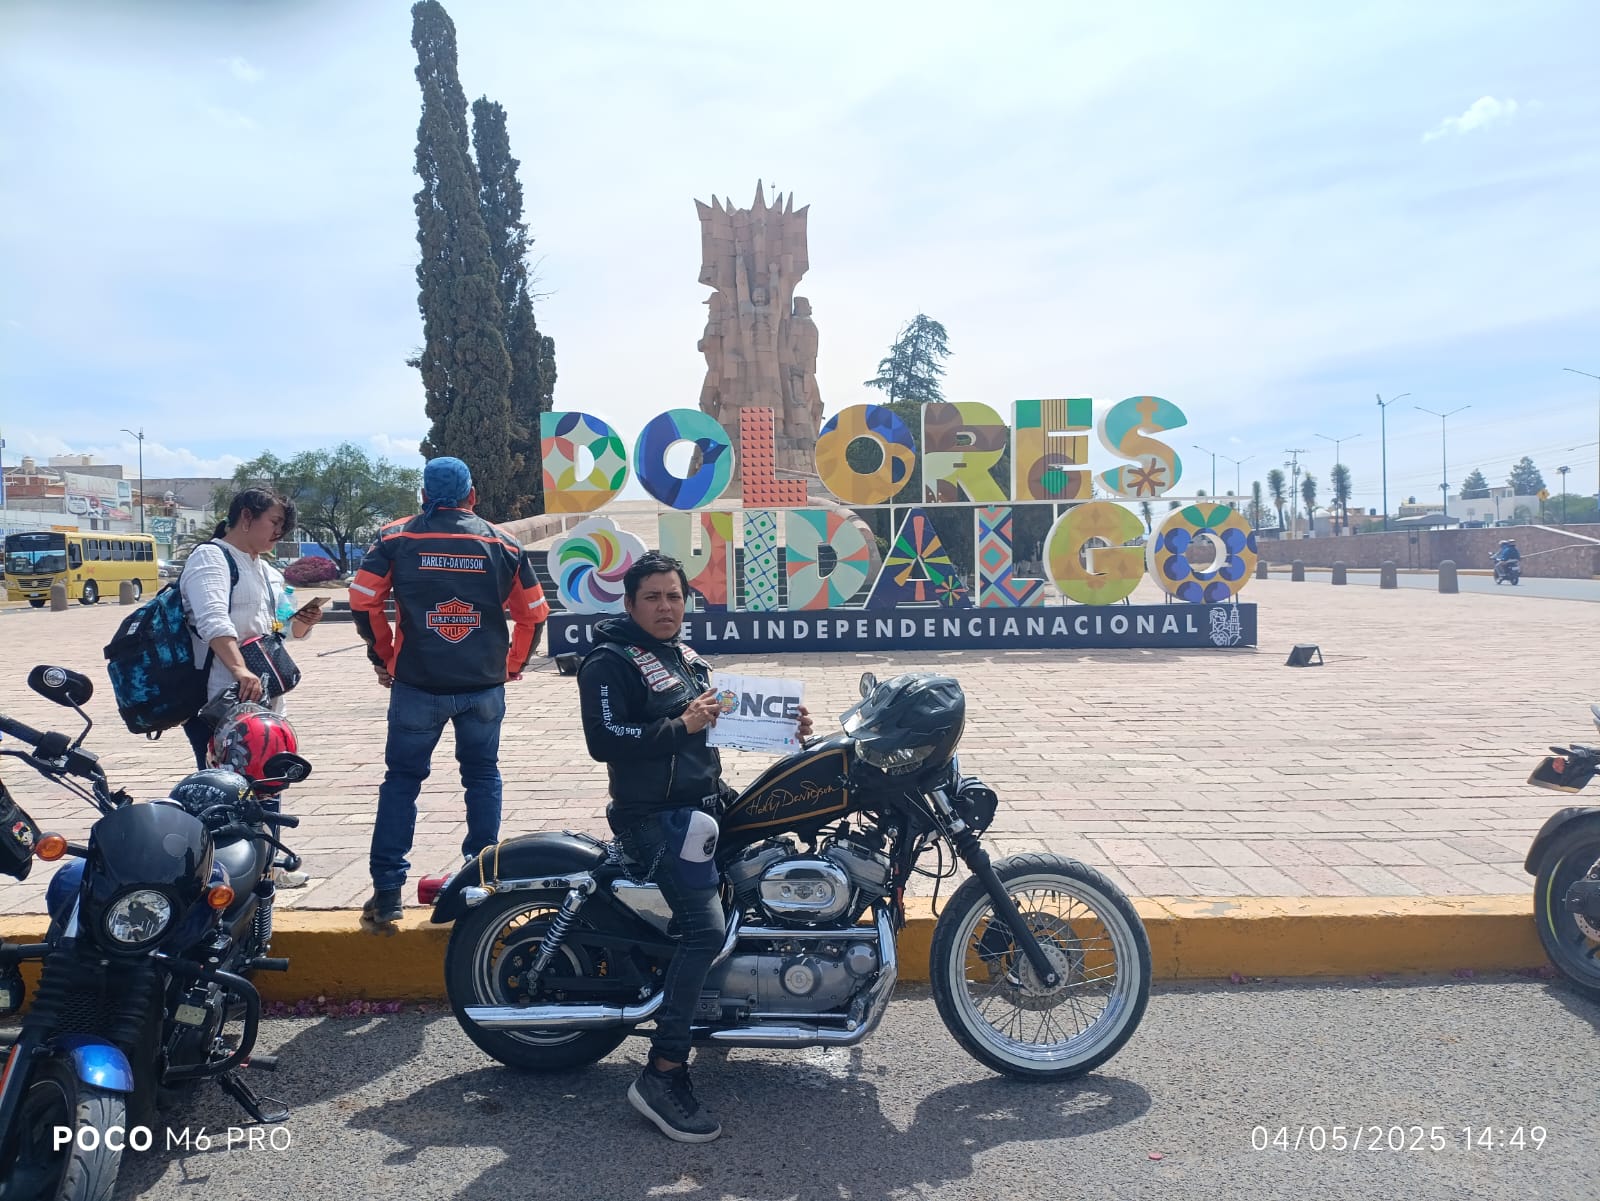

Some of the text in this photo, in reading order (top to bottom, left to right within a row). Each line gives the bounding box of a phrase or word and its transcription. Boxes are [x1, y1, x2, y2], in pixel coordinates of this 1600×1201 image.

[539, 395, 1188, 514] DOLORES
[421, 555, 484, 570] HARLEY-DAVIDSON
[658, 501, 1258, 612] HIDALGO
[440, 605, 468, 614] MOTOR
[431, 615, 477, 625] HARLEY-DAVIDSON
[441, 626, 468, 638] CYCLES
[706, 620, 740, 641] LA
